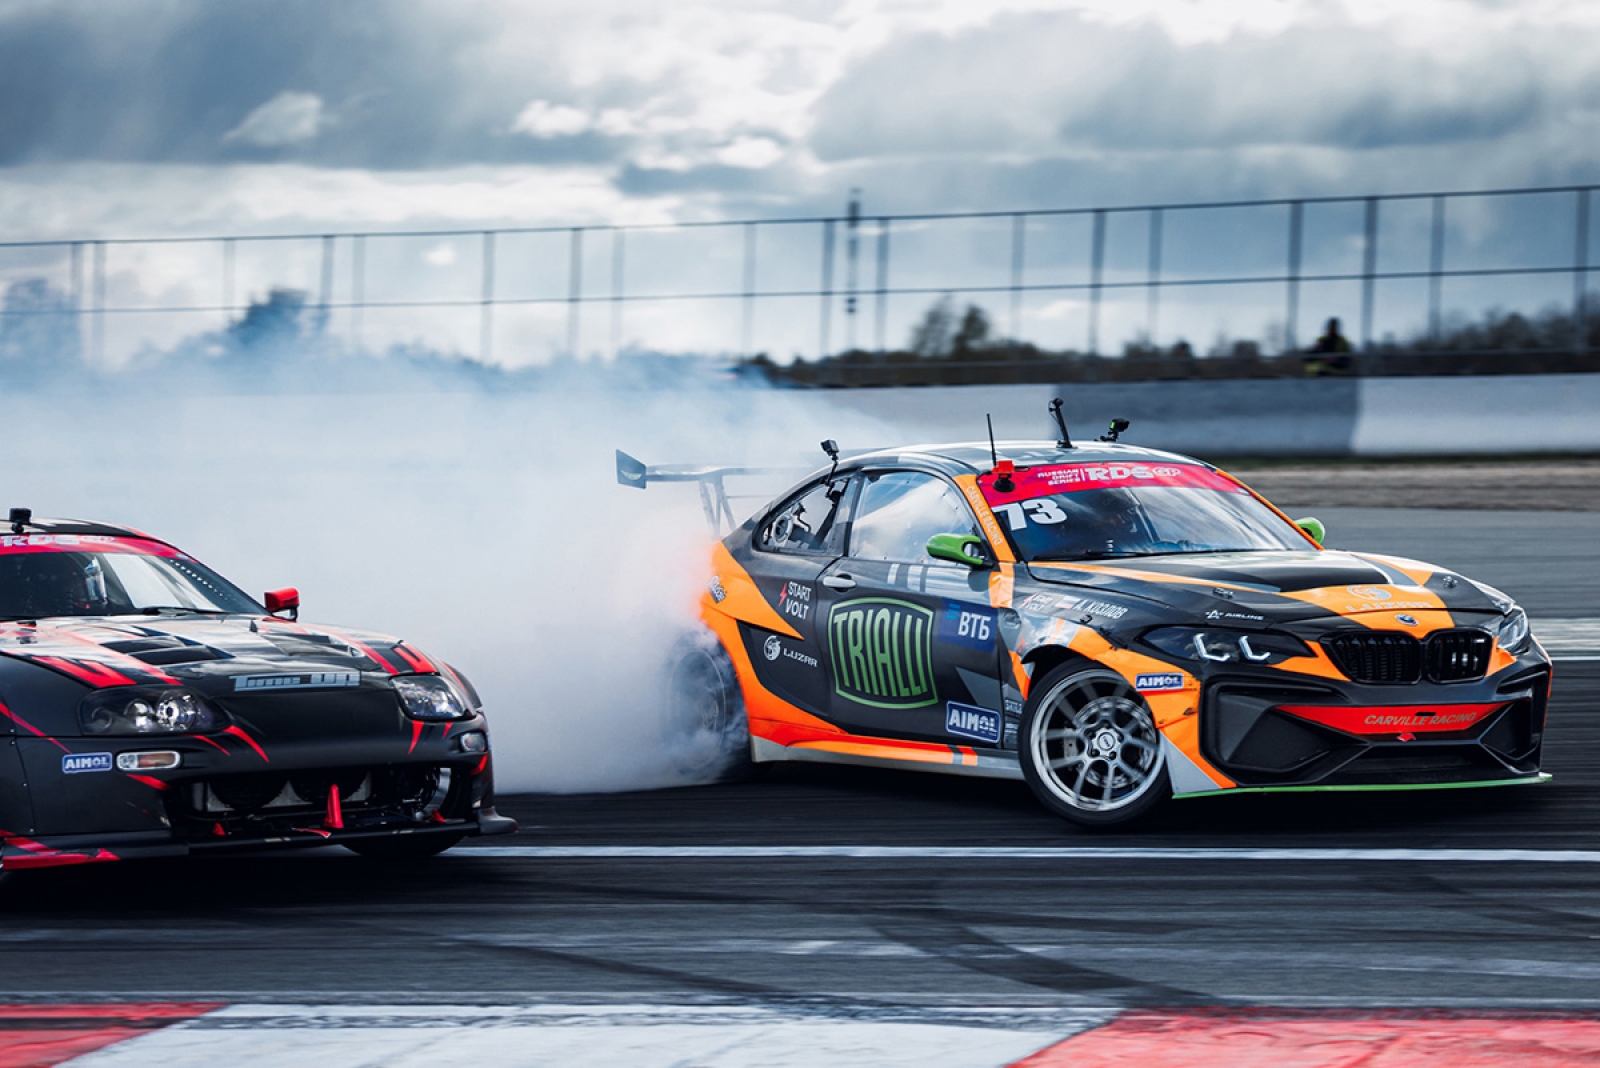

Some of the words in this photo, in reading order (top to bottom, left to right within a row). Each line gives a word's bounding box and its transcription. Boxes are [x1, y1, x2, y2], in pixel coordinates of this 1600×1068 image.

[1085, 466, 1154, 481] RDS
[965, 485, 989, 518] CARVILLE
[983, 515, 1004, 547] RACING
[991, 498, 1068, 532] 73
[787, 580, 812, 602] START
[785, 598, 809, 620] VOLT
[1225, 611, 1265, 621] AIRLINE
[957, 611, 992, 641] ВТБ
[783, 648, 818, 667] LUZAR
[833, 607, 928, 697] TRIALLI
[1137, 676, 1181, 687] AIMOL
[948, 708, 998, 734] AIMOL
[1364, 714, 1429, 726] CARVILLE
[1428, 711, 1477, 725] RACING
[64, 756, 109, 769] AIMOL
